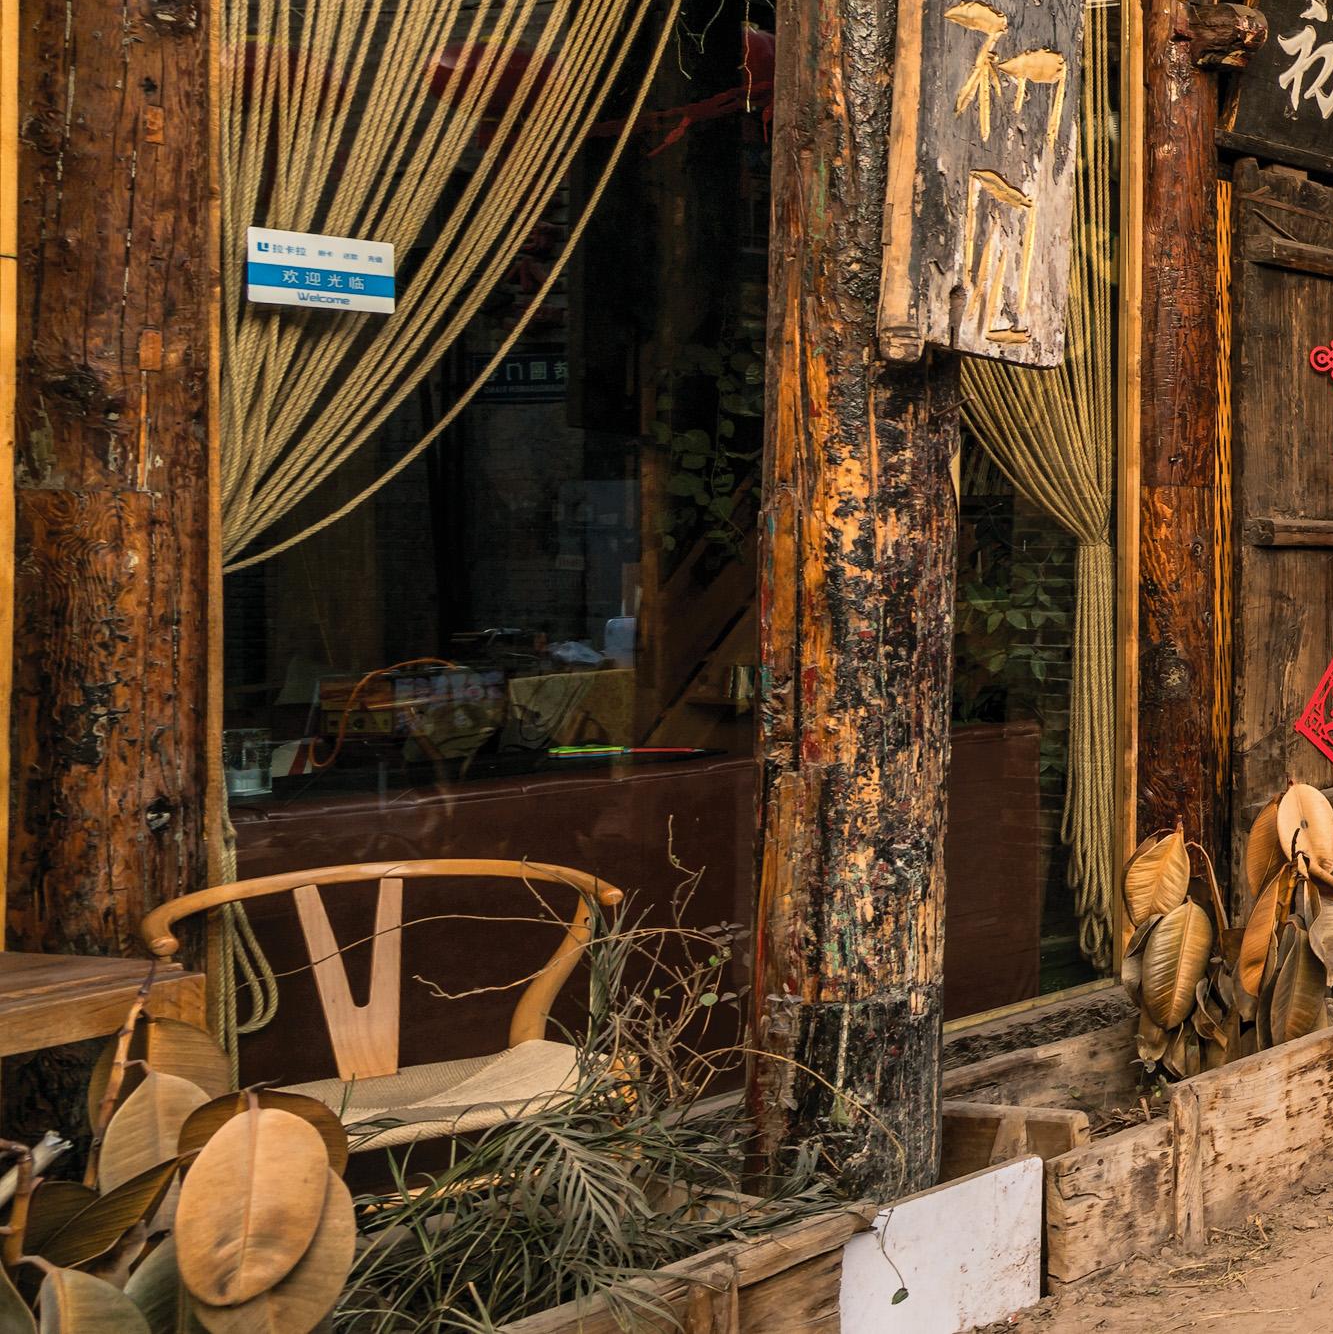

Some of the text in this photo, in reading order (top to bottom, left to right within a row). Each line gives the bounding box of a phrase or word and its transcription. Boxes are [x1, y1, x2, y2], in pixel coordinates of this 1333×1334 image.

[272, 243, 306, 256] 拉卡拉
[281, 269, 365, 291] 欢迎光临
[297, 291, 351, 305] Welcome
